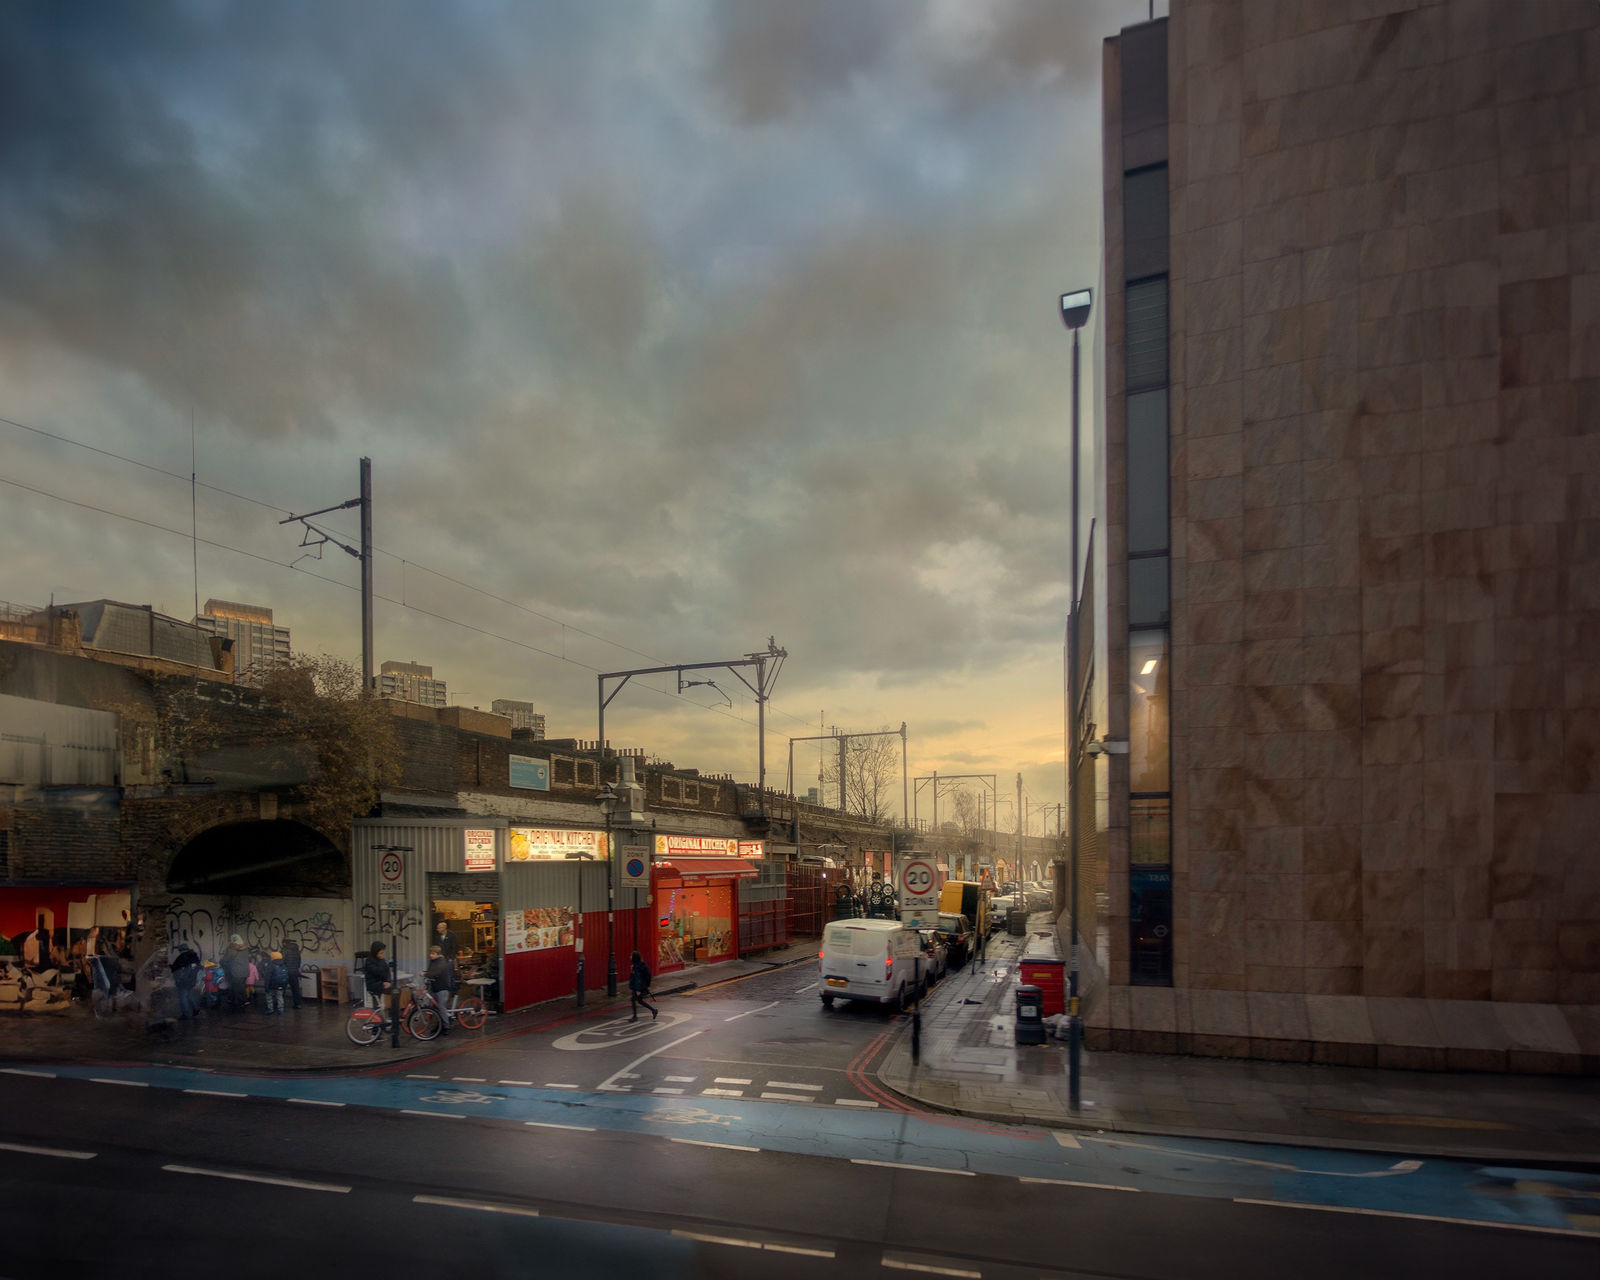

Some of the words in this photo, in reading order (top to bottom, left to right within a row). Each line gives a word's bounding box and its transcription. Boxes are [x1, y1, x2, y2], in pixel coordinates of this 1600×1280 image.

[531, 830, 565, 845] ORIGINAL
[567, 831, 595, 845] KITCHEN
[669, 836, 700, 849] ORIGINAL
[701, 838, 727, 850] KITCHEN
[384, 861, 399, 872] 20
[908, 871, 930, 885] 20
[904, 897, 934, 906] ZONE
